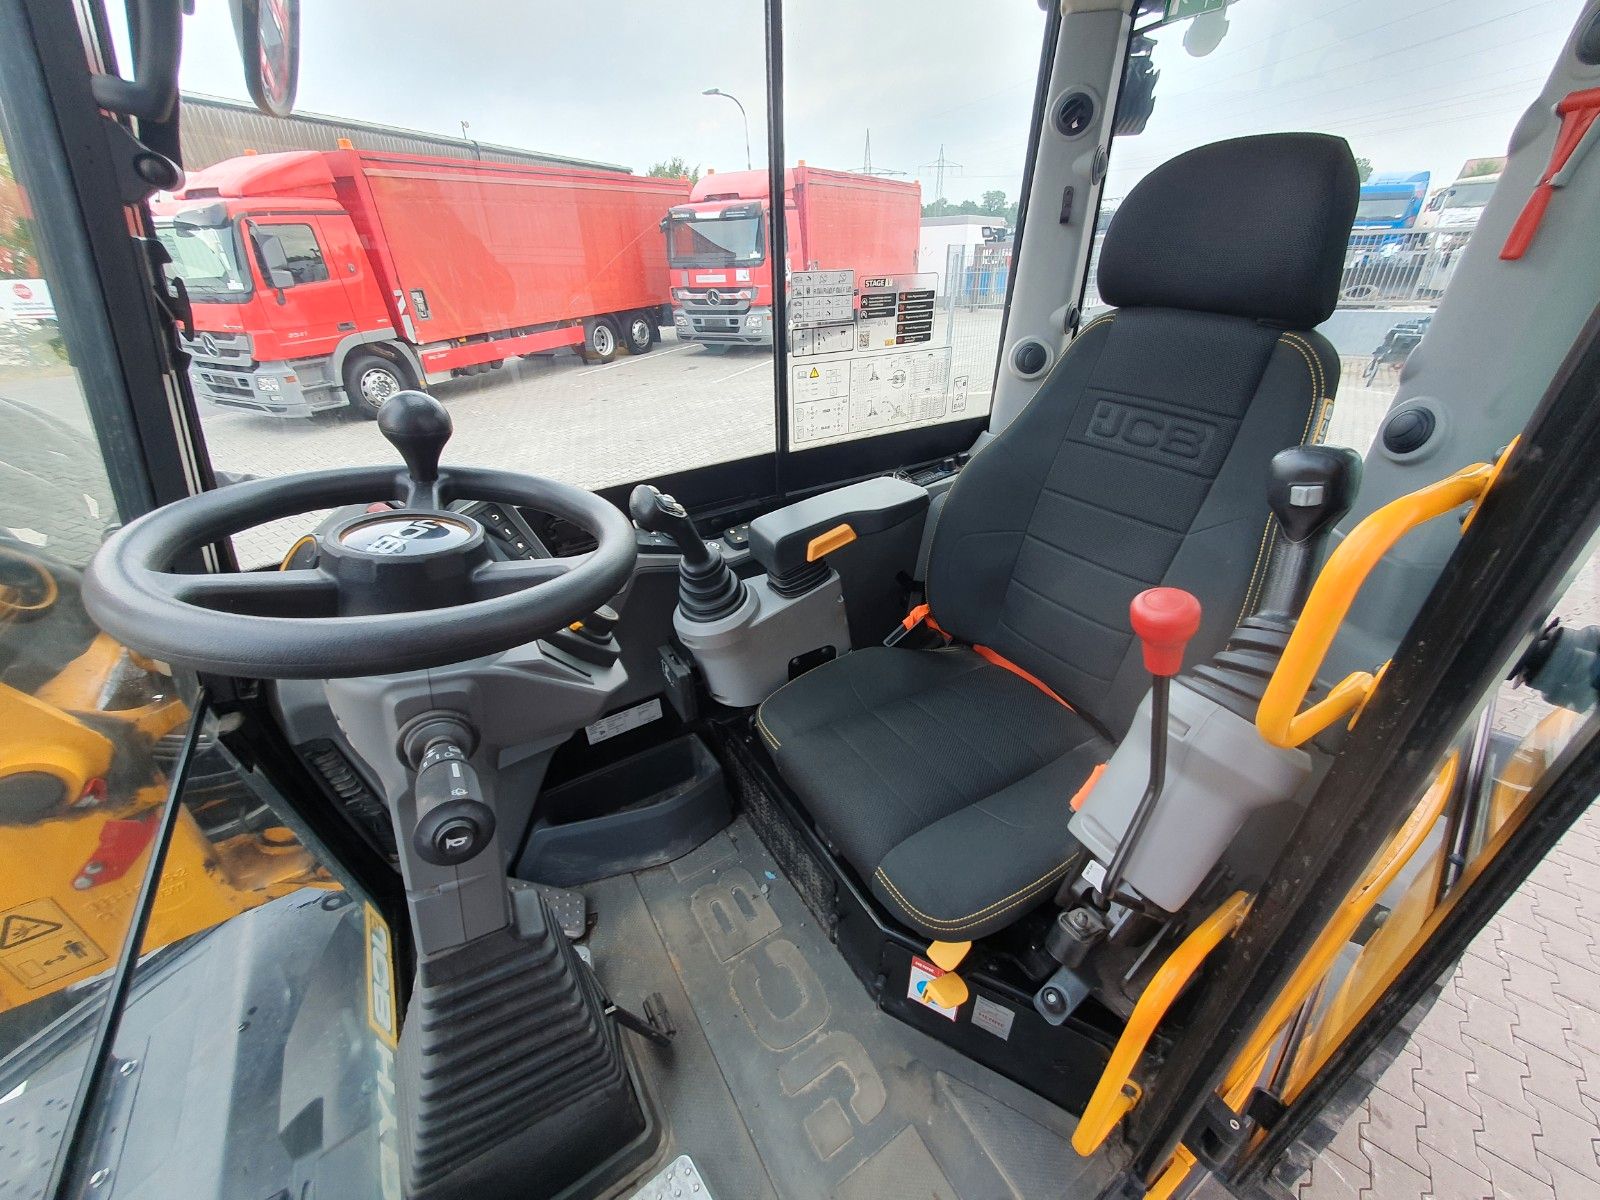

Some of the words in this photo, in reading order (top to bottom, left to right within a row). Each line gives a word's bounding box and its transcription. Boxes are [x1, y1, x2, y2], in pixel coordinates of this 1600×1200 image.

[865, 279, 885, 288] STAGE
[1090, 403, 1207, 460] JCB
[365, 519, 444, 554] JCB
[690, 867, 887, 1161] JCB
